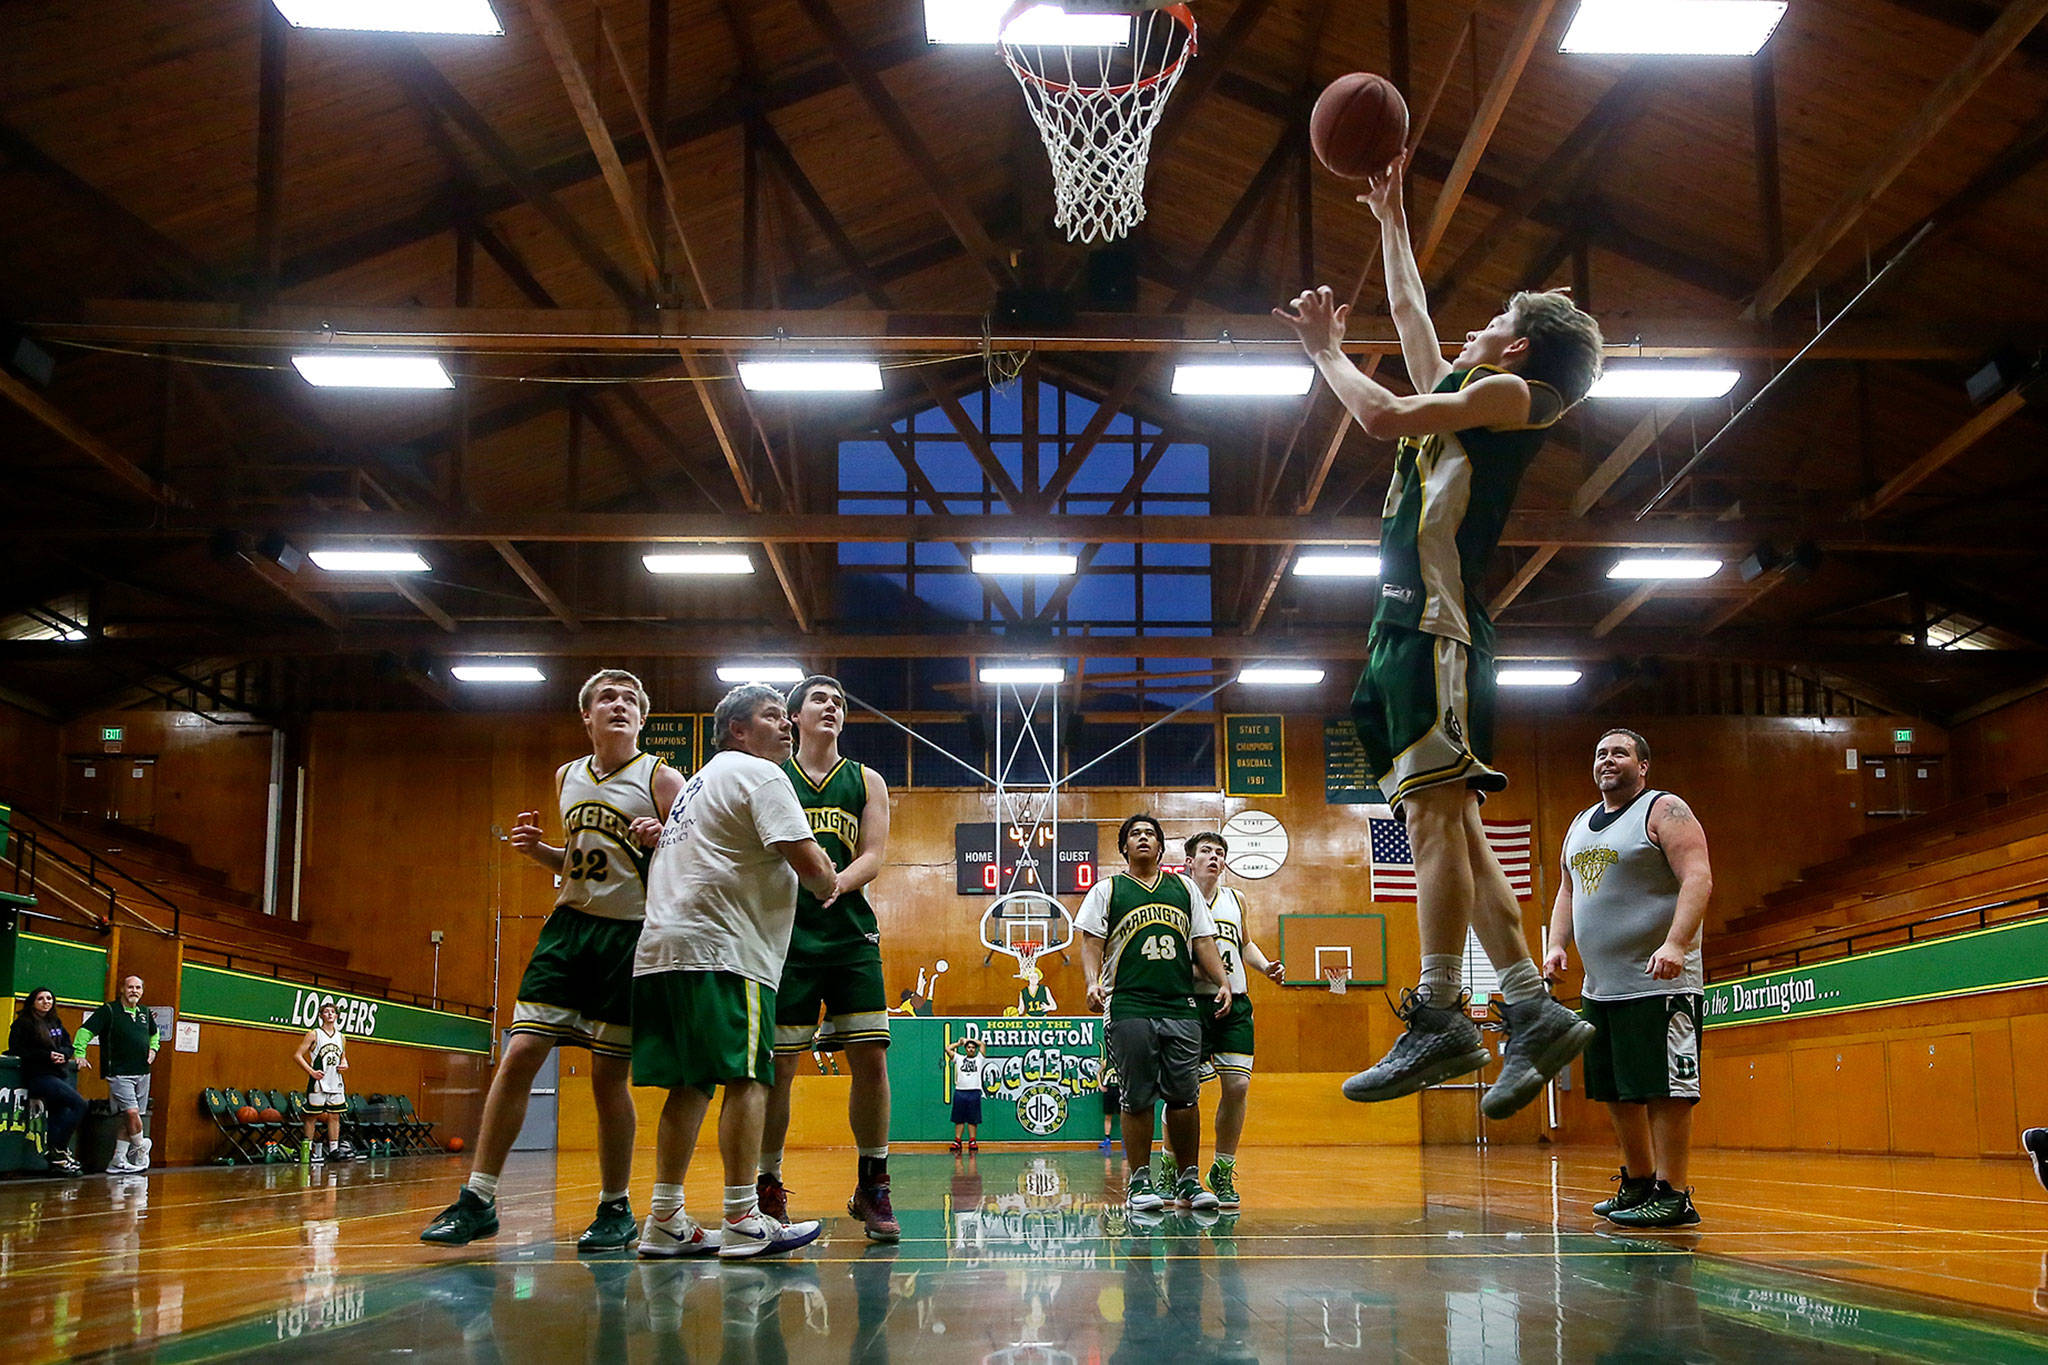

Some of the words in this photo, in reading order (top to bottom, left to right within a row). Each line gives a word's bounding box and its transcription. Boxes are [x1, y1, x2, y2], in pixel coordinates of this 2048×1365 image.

[1239, 725, 1261, 734] STATE
[645, 737, 687, 745] CHAMPIONS
[1236, 742, 1273, 751] CHAMPIONS
[1237, 759, 1272, 768] BASEBALL
[965, 851, 993, 863] HOME
[1059, 851, 1090, 862] GUEST
[569, 848, 607, 882] 22
[984, 865, 998, 888] 0
[1077, 864, 1092, 887] 0
[1141, 934, 1176, 960] 43
[1028, 1001, 1043, 1012] 11
[1711, 989, 1729, 1015] the
[987, 1021, 1023, 1029] HOME
[1026, 1021, 1042, 1029] OF
[1049, 1021, 1072, 1029] THE
[966, 1022, 1094, 1046] DARRINGTON
[1028, 1095, 1056, 1123] dhs
